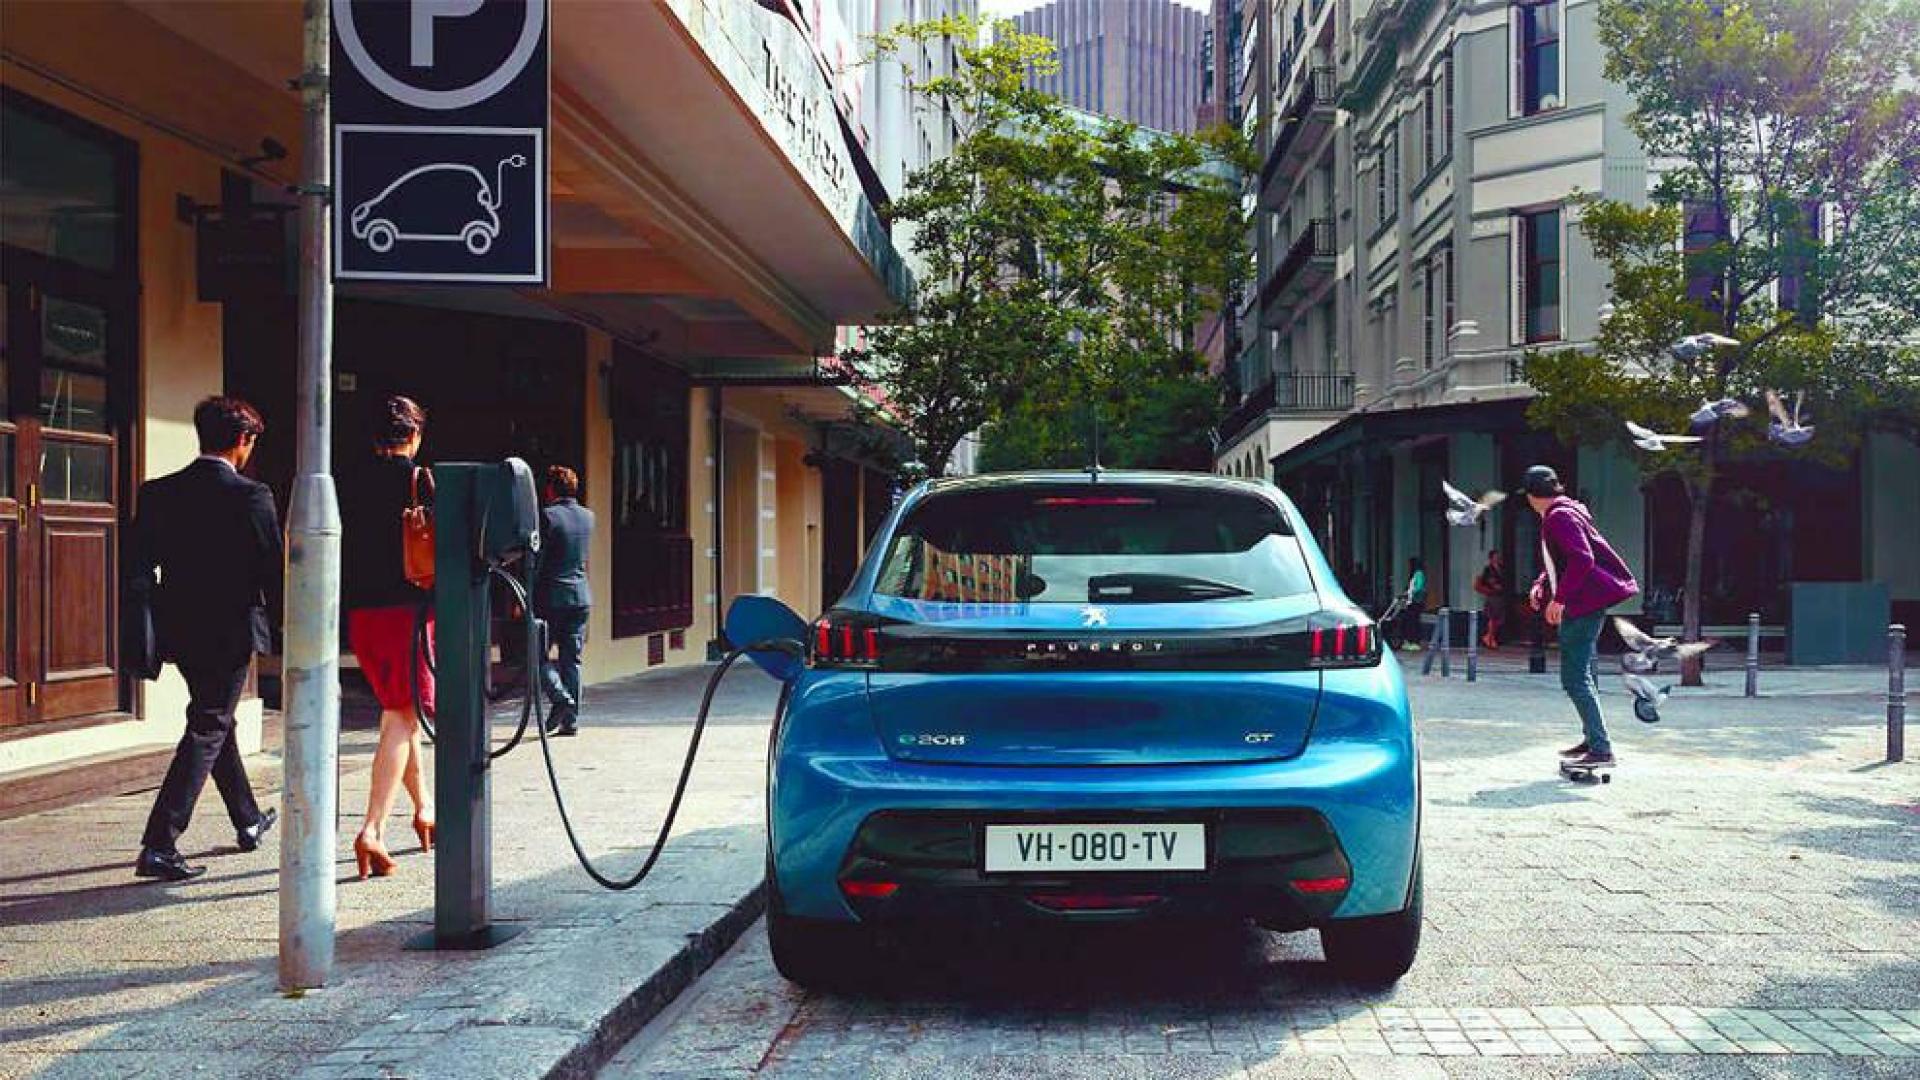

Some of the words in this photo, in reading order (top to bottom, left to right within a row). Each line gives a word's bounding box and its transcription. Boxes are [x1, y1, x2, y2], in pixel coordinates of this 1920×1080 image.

[1026, 642, 1163, 652] PEUGEOT
[1244, 733, 1274, 744] GT
[1016, 831, 1178, 862] VH-080-TV
